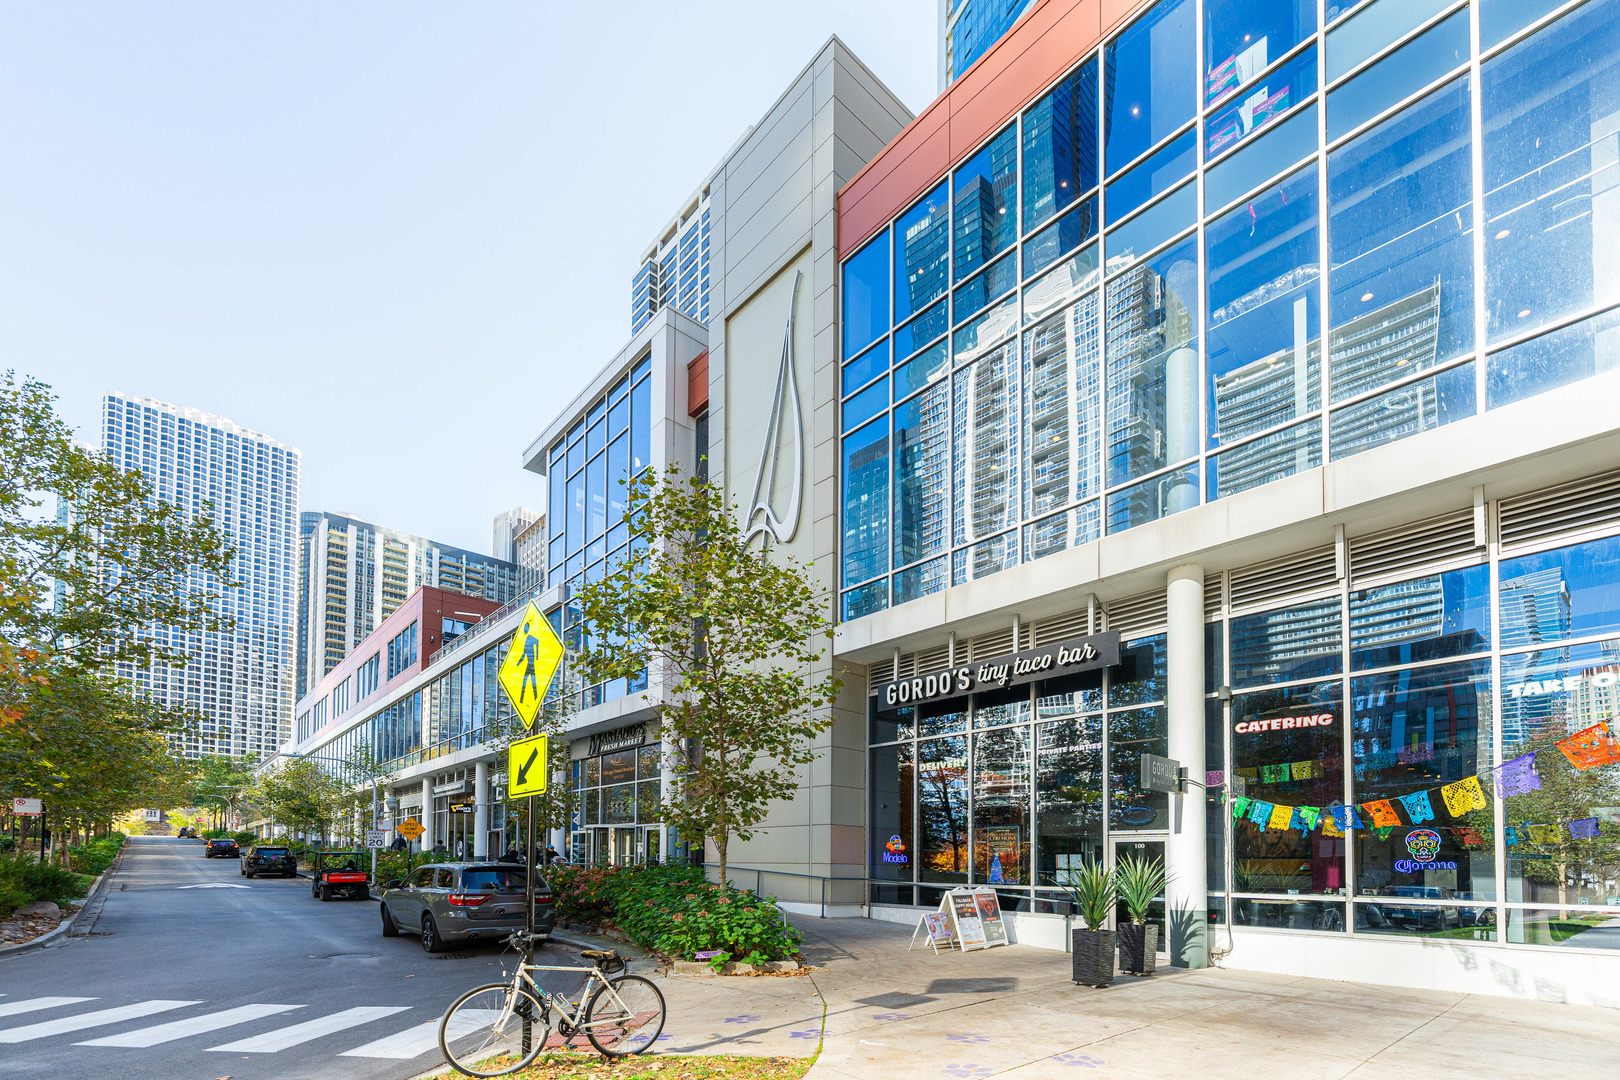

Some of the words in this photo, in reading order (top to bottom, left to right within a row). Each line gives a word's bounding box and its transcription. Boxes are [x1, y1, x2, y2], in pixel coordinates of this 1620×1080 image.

[886, 667, 970, 705] GORDO'S
[977, 663, 1010, 687] tiny
[1013, 654, 1051, 675] taco
[1057, 642, 1096, 666] bar
[1506, 675, 1582, 698] TAKE
[1591, 670, 1620, 688] O
[1234, 713, 1334, 734] CATERING
[600, 742, 618, 752] FRESH
[619, 736, 643, 746] MARKET
[1037, 746, 1068, 755] PRIVATE
[1069, 743, 1102, 753] PARTIES
[919, 757, 967, 772] DELIVERY
[1152, 761, 1177, 778] GORDO'S
[368, 839, 383, 847] 20
[882, 851, 908, 864] Modelo
[1394, 859, 1457, 874] Corona
